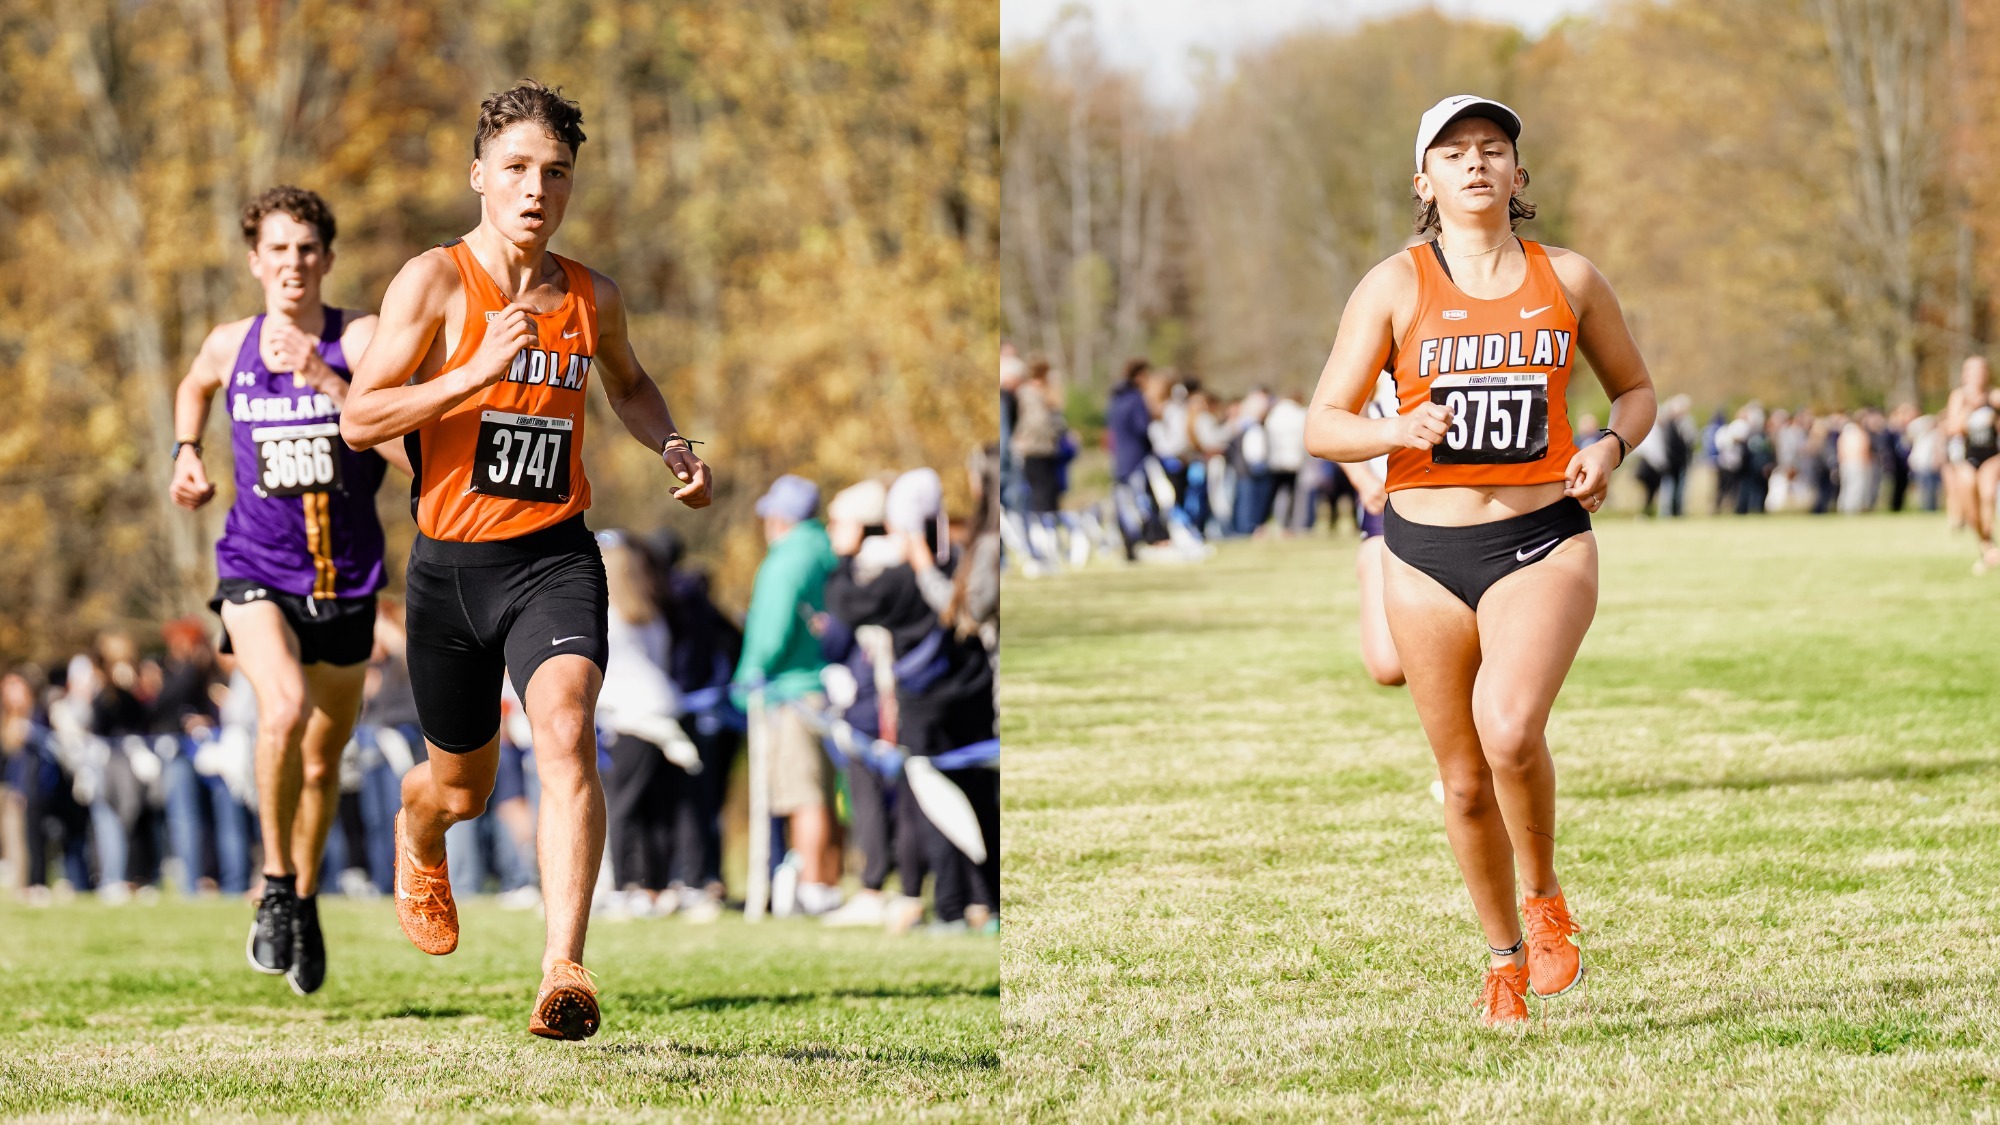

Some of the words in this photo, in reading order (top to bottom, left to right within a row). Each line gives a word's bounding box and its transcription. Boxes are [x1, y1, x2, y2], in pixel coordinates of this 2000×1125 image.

[500, 347, 592, 391] NDLAY
[1419, 329, 1571, 378] FINDLAY
[1445, 390, 1532, 450] 3757
[261, 437, 334, 489] 3666
[488, 428, 562, 489] 3747
